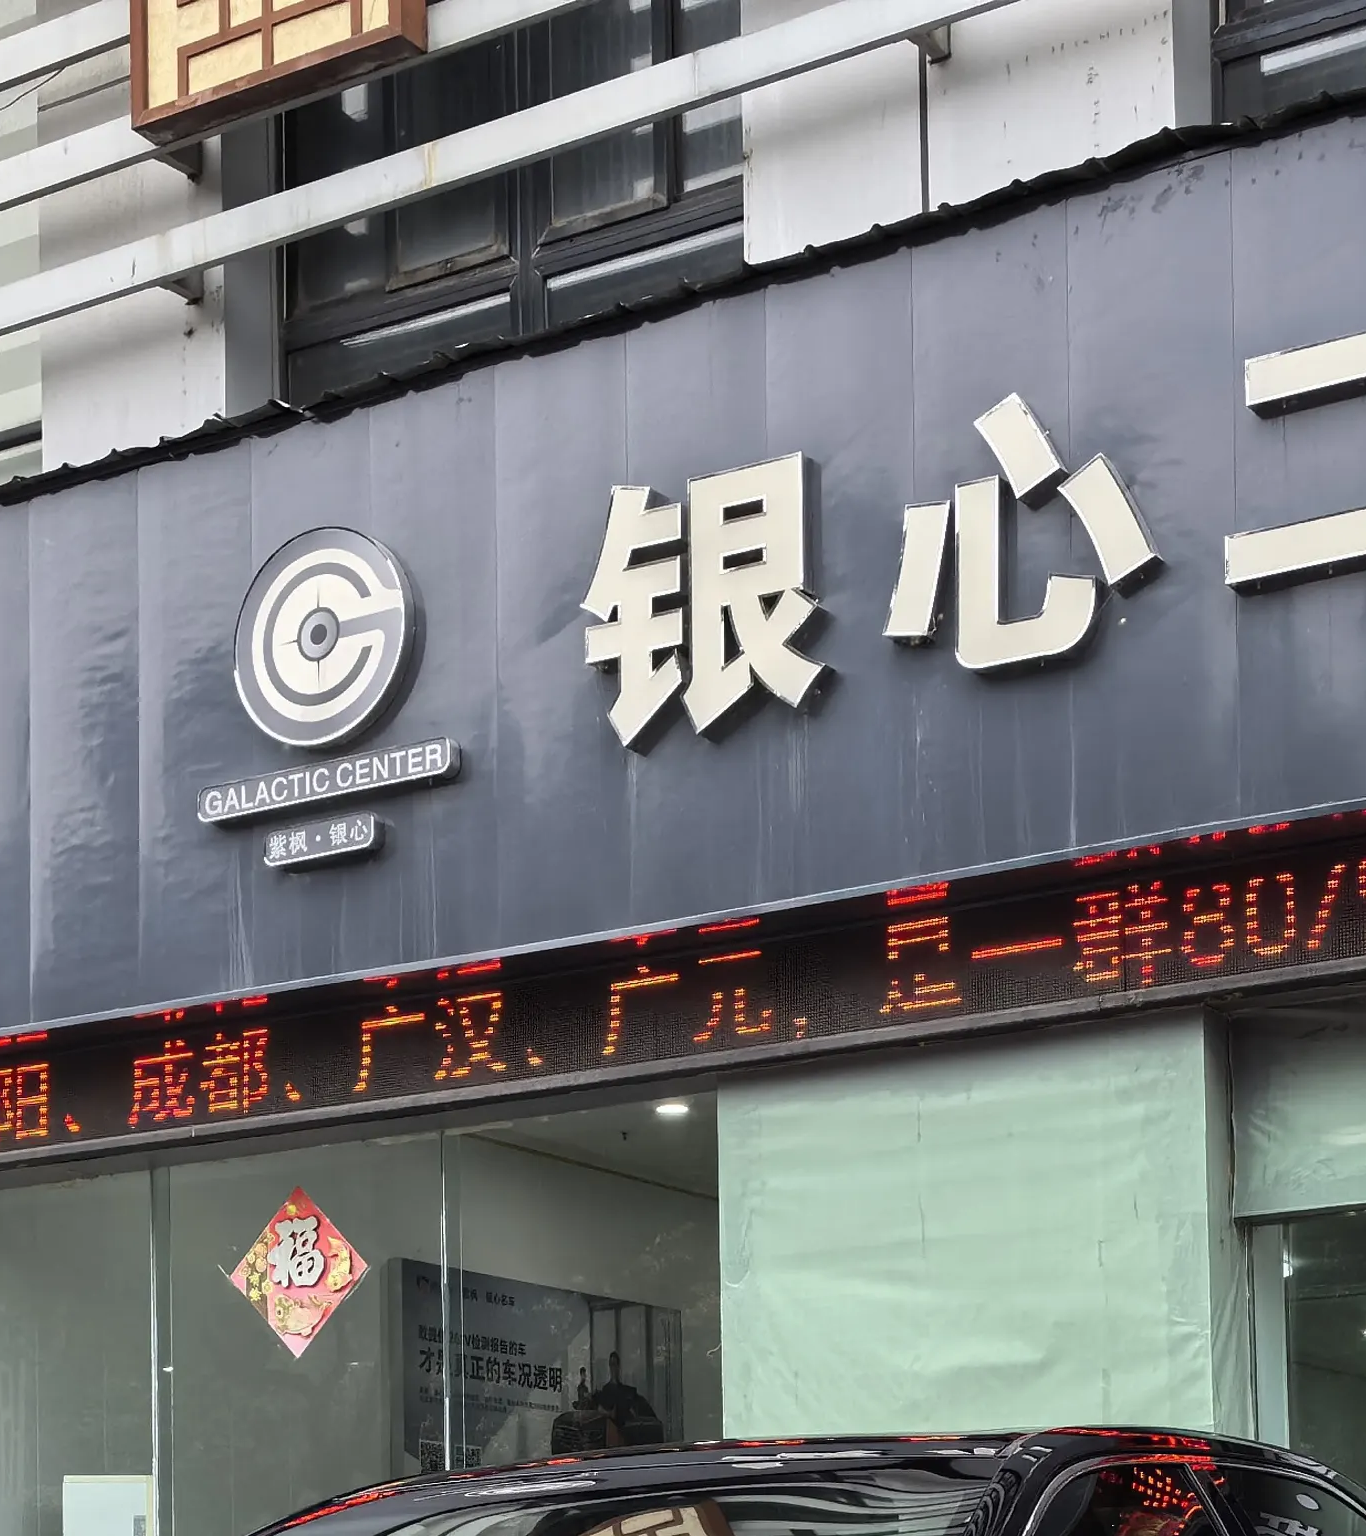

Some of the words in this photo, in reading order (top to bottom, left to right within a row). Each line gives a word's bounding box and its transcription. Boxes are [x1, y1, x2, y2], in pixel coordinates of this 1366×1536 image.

[205, 767, 330, 816] GALACTIC
[336, 743, 443, 788] CENTER
[267, 1215, 326, 1289] 福
